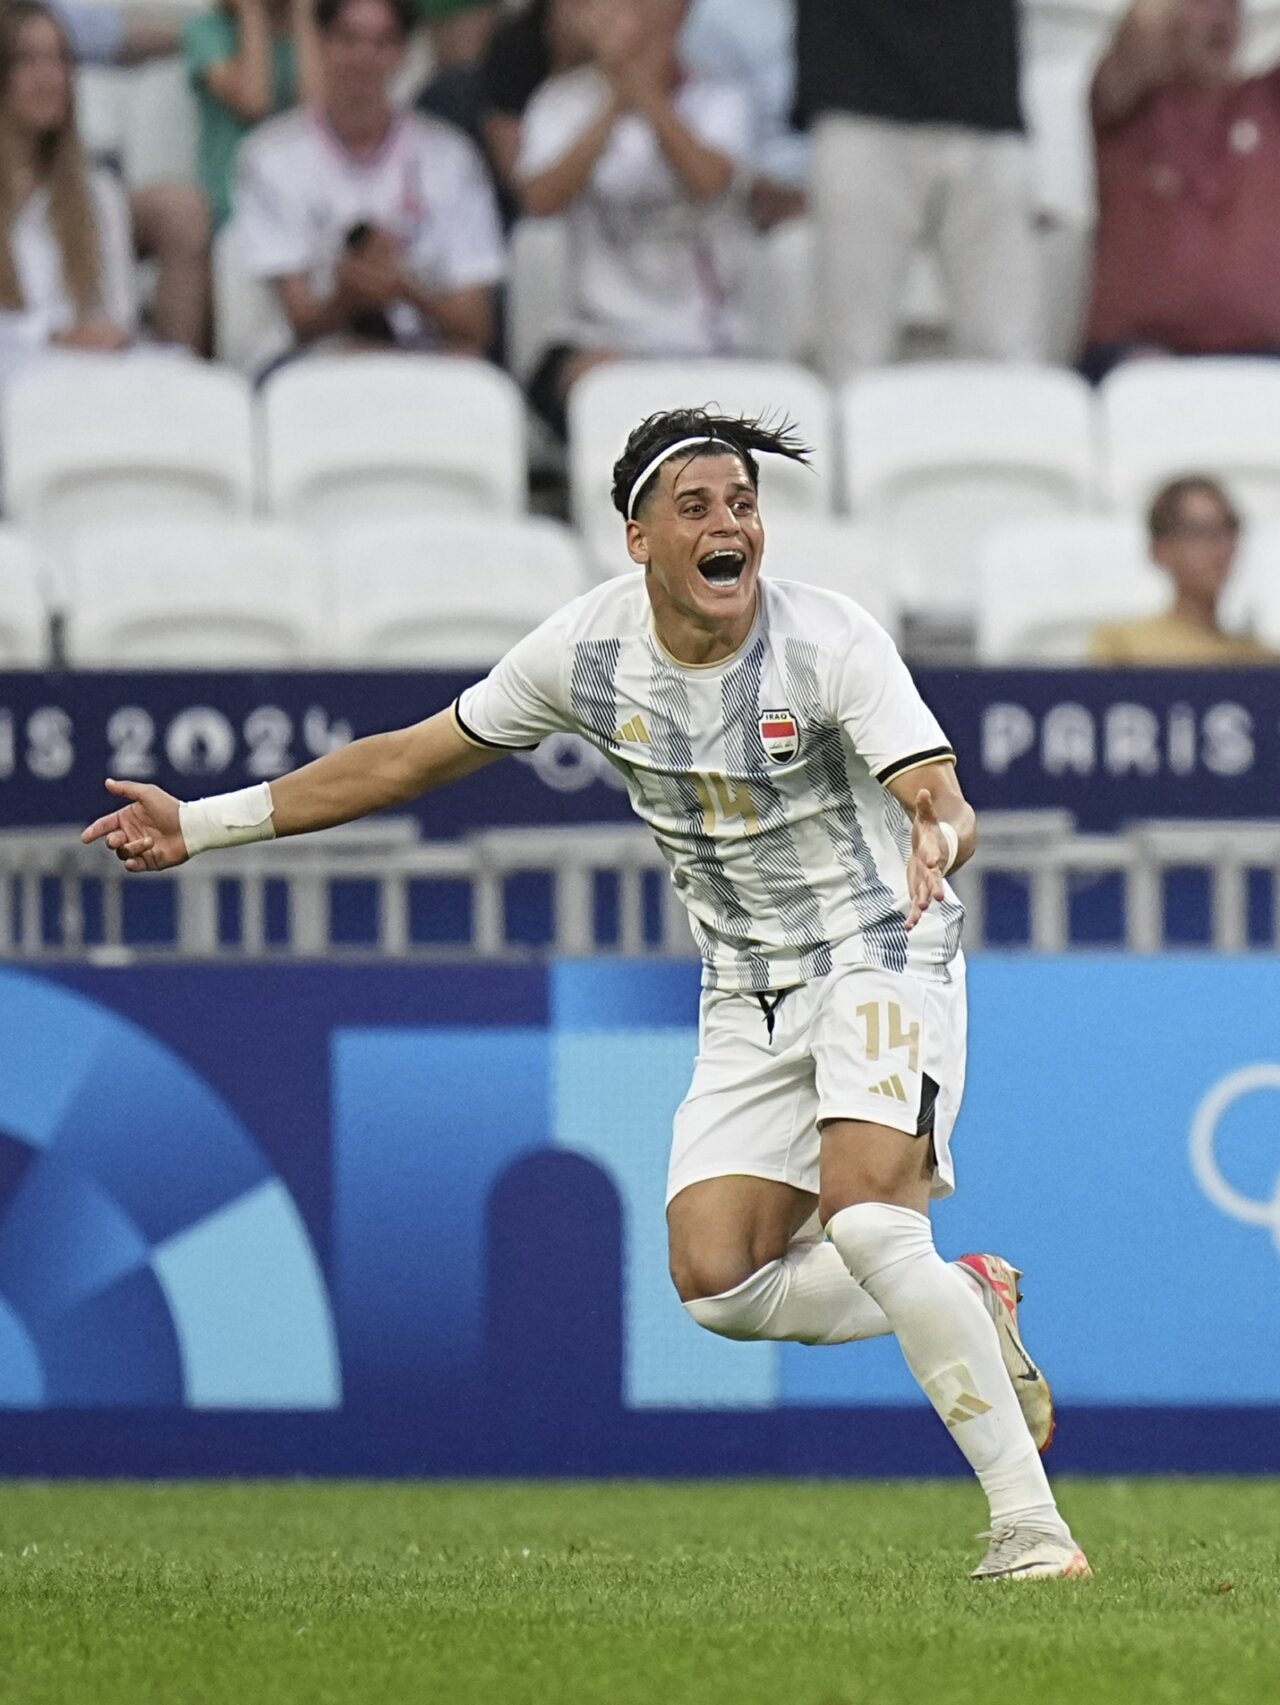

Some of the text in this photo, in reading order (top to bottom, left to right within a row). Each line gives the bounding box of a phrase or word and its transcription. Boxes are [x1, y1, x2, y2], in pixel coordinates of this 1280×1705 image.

[105, 703, 354, 778] 2024
[765, 712, 788, 720] IRAQ
[684, 771, 759, 833] 14
[856, 1001, 920, 1074] 14
